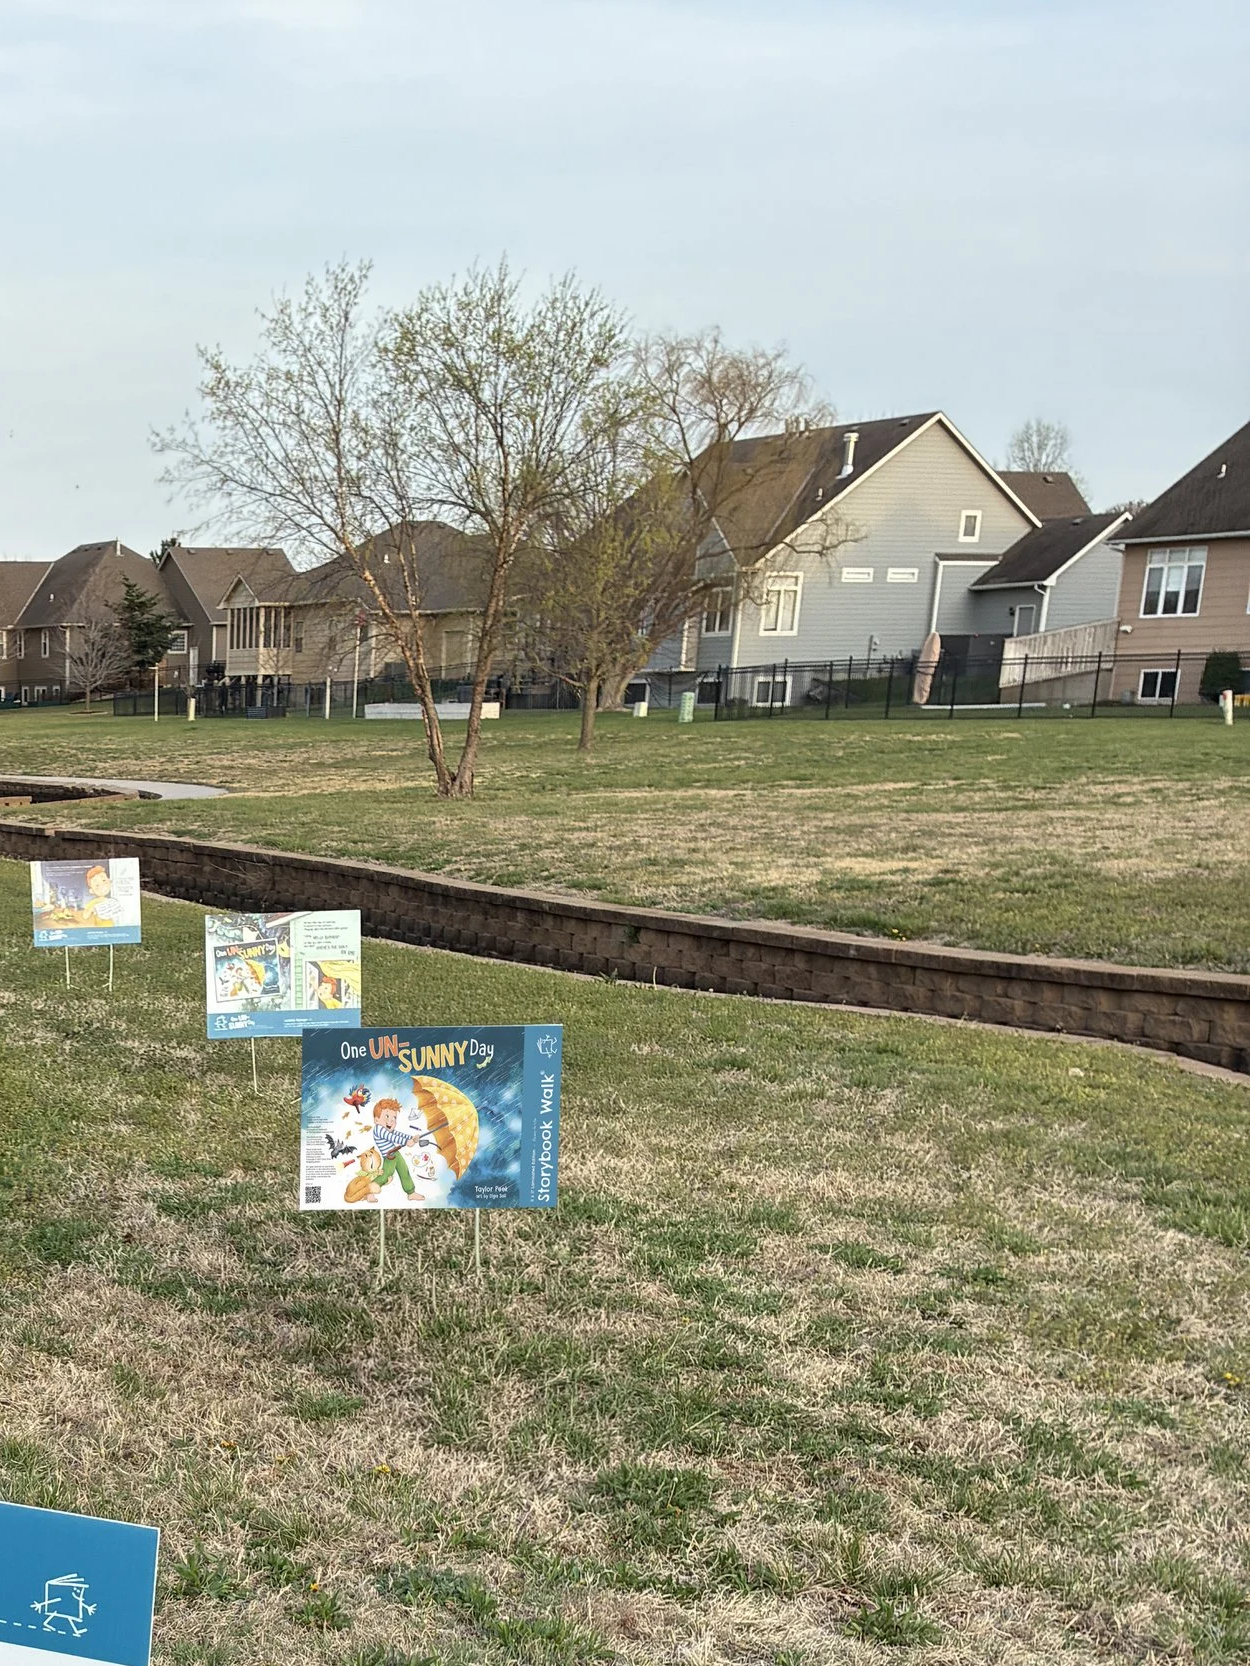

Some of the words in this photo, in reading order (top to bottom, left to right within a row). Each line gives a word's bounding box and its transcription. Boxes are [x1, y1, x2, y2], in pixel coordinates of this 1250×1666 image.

[340, 1041, 367, 1060] One
[369, 1034, 410, 1060] UN-
[398, 1040, 469, 1073] SUNNY
[469, 1038, 494, 1062] Day
[538, 1120, 554, 1203] Storybook
[475, 1186, 493, 1194] Taylor
